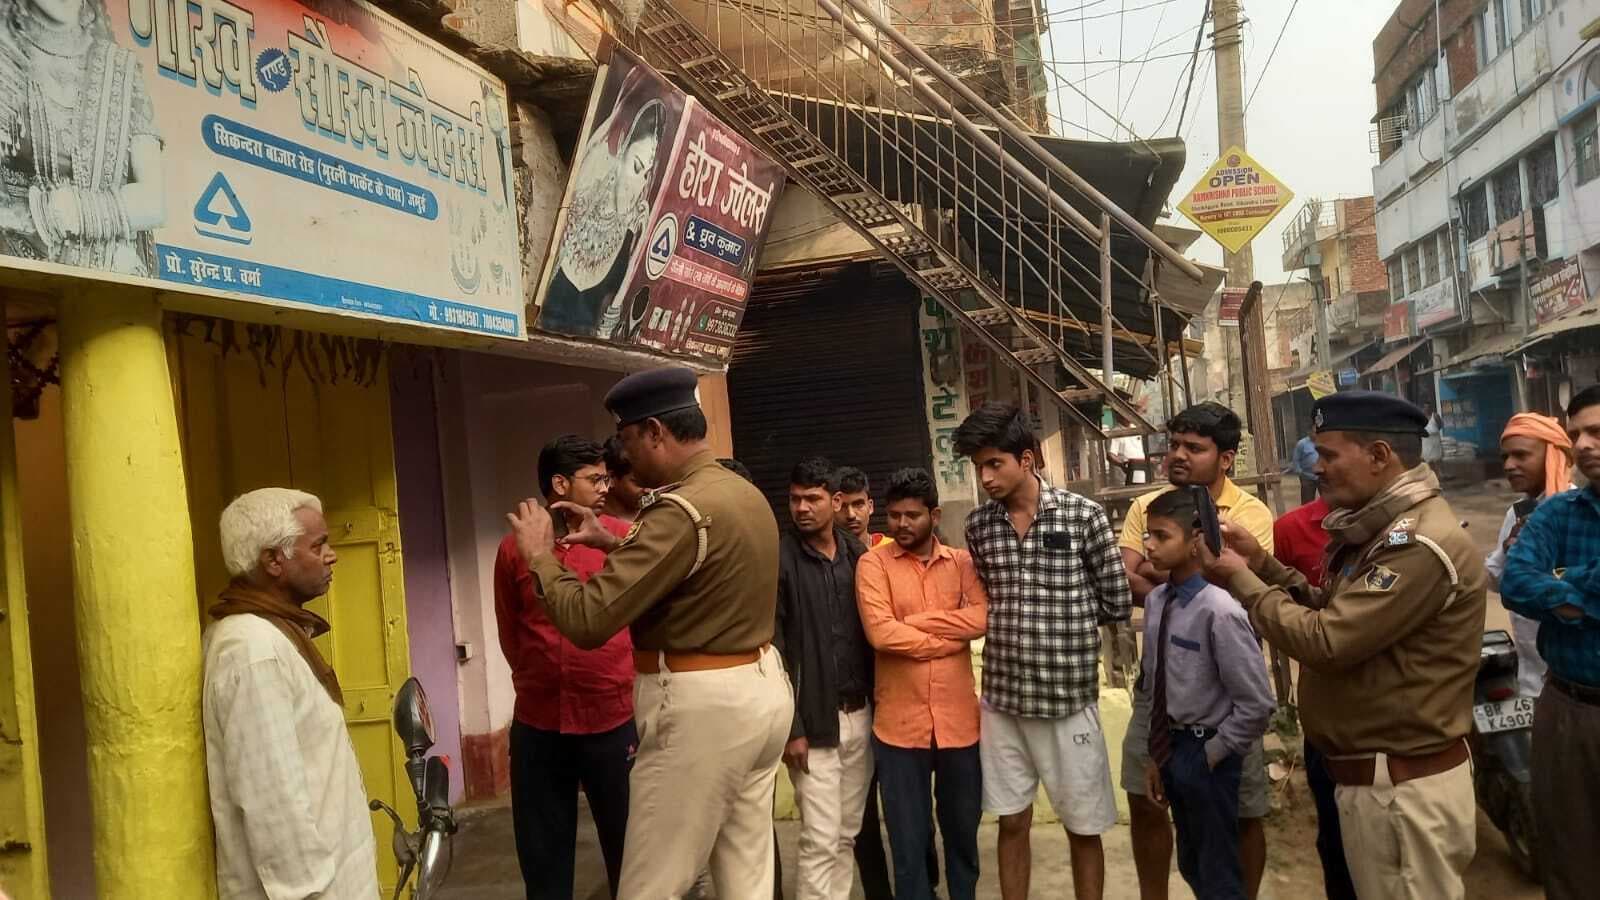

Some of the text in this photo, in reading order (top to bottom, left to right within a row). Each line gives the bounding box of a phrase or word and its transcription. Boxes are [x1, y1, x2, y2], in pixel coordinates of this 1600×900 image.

[288, 16, 388, 156] सौरव
[264, 144, 297, 168] बाजार
[298, 151, 315, 174] रोड
[374, 178, 384, 196] के
[1216, 167, 1253, 176] ADMISSION
[679, 130, 724, 208] हीरा
[720, 162, 774, 235] ज्वेलर्स
[1209, 173, 1260, 188] OPEN
[1231, 187, 1252, 198] PUBLIC
[1254, 184, 1277, 196] SCHOOL
[686, 221, 695, 241] &
[717, 235, 741, 256] कुमार
[1484, 698, 1531, 718] BR 46
[1072, 733, 1091, 745] CK
